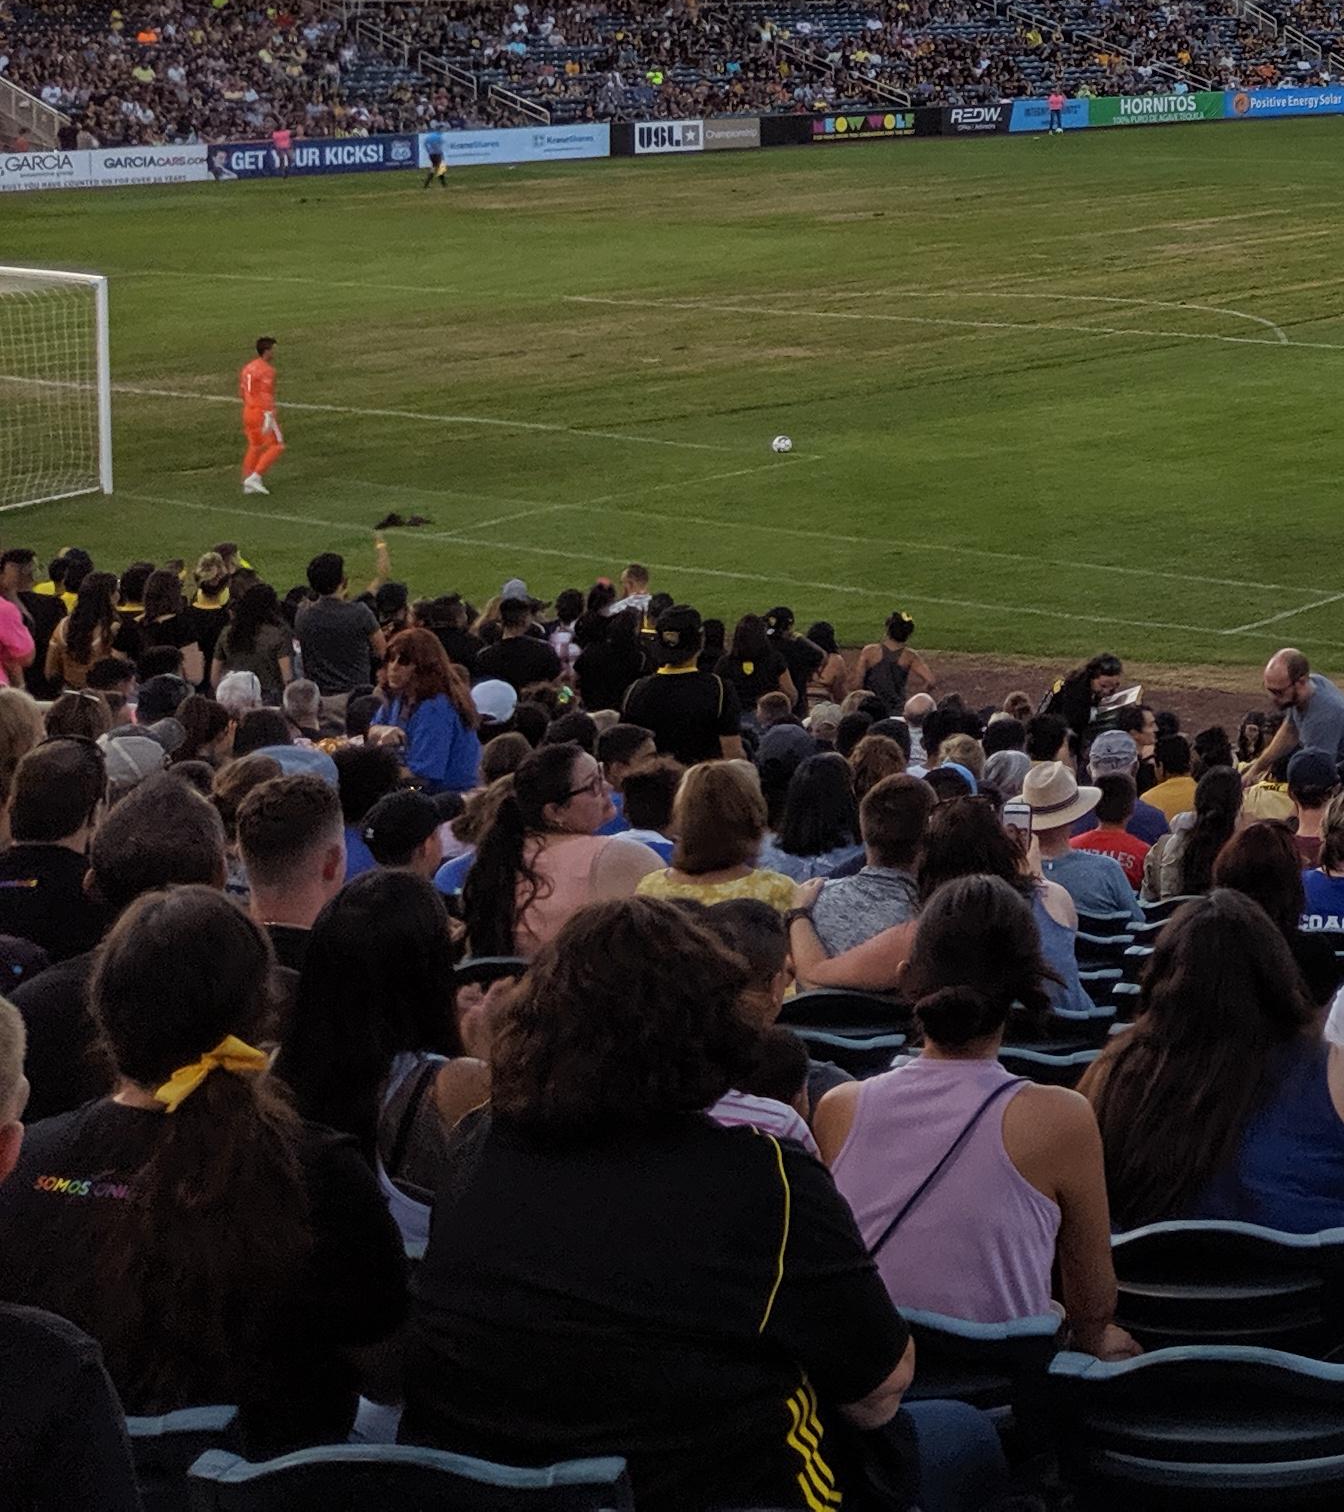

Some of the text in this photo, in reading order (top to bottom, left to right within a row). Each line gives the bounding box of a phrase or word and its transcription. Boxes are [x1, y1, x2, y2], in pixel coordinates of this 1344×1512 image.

[1120, 95, 1197, 115] HORNITOS
[1250, 96, 1287, 109] Positive
[1288, 94, 1319, 109] Energy
[1319, 94, 1343, 106] Solar
[638, 126, 682, 149] USL
[705, 126, 758, 140] Championship
[5, 154, 74, 172] GARCIA
[231, 144, 384, 170] GET KICKS!
[63, 179, 99, 187] COUNTED
[115, 177, 129, 185] FOR
[131, 176, 151, 184] OVER
[34, 1175, 92, 1196] SOMOS
